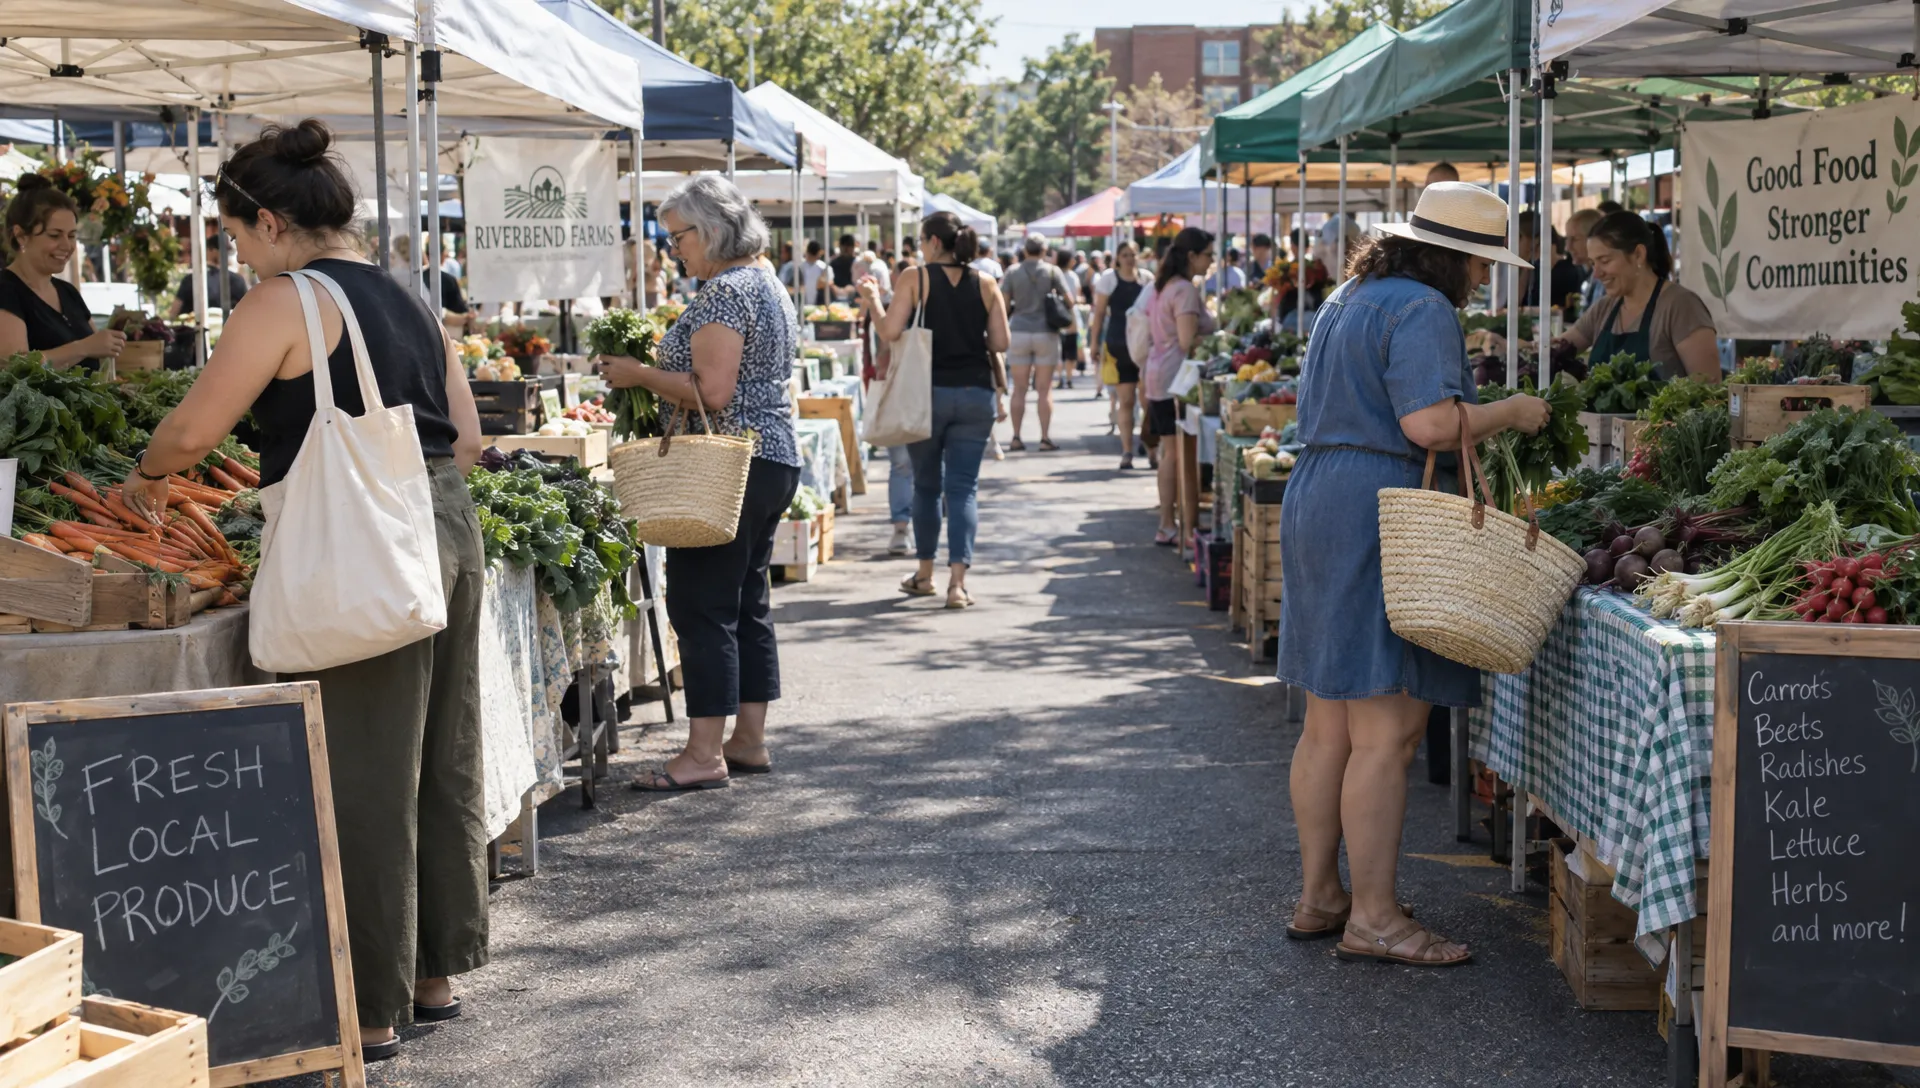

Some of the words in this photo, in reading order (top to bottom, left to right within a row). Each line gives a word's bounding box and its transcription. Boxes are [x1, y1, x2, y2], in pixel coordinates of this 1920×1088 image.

[1747, 149, 1803, 193] Good
[1813, 139, 1877, 185] Food
[475, 225, 566, 249] RIVERBEND
[571, 224, 614, 247] FARMS
[1768, 205, 1870, 244] Stronger
[1746, 248, 1908, 290] Communities
[1748, 670, 1832, 705] Carrots
[1754, 712, 1824, 747] Beets
[82, 745, 263, 815] FRESH
[1760, 748, 1866, 783] Radishes
[1765, 787, 1830, 823] Kale
[92, 810, 259, 876] LOCAL
[1770, 828, 1866, 860] Lettuce
[1772, 871, 1848, 906] Herbs
[91, 864, 296, 951] PRODUCE
[1772, 913, 1820, 942] and
